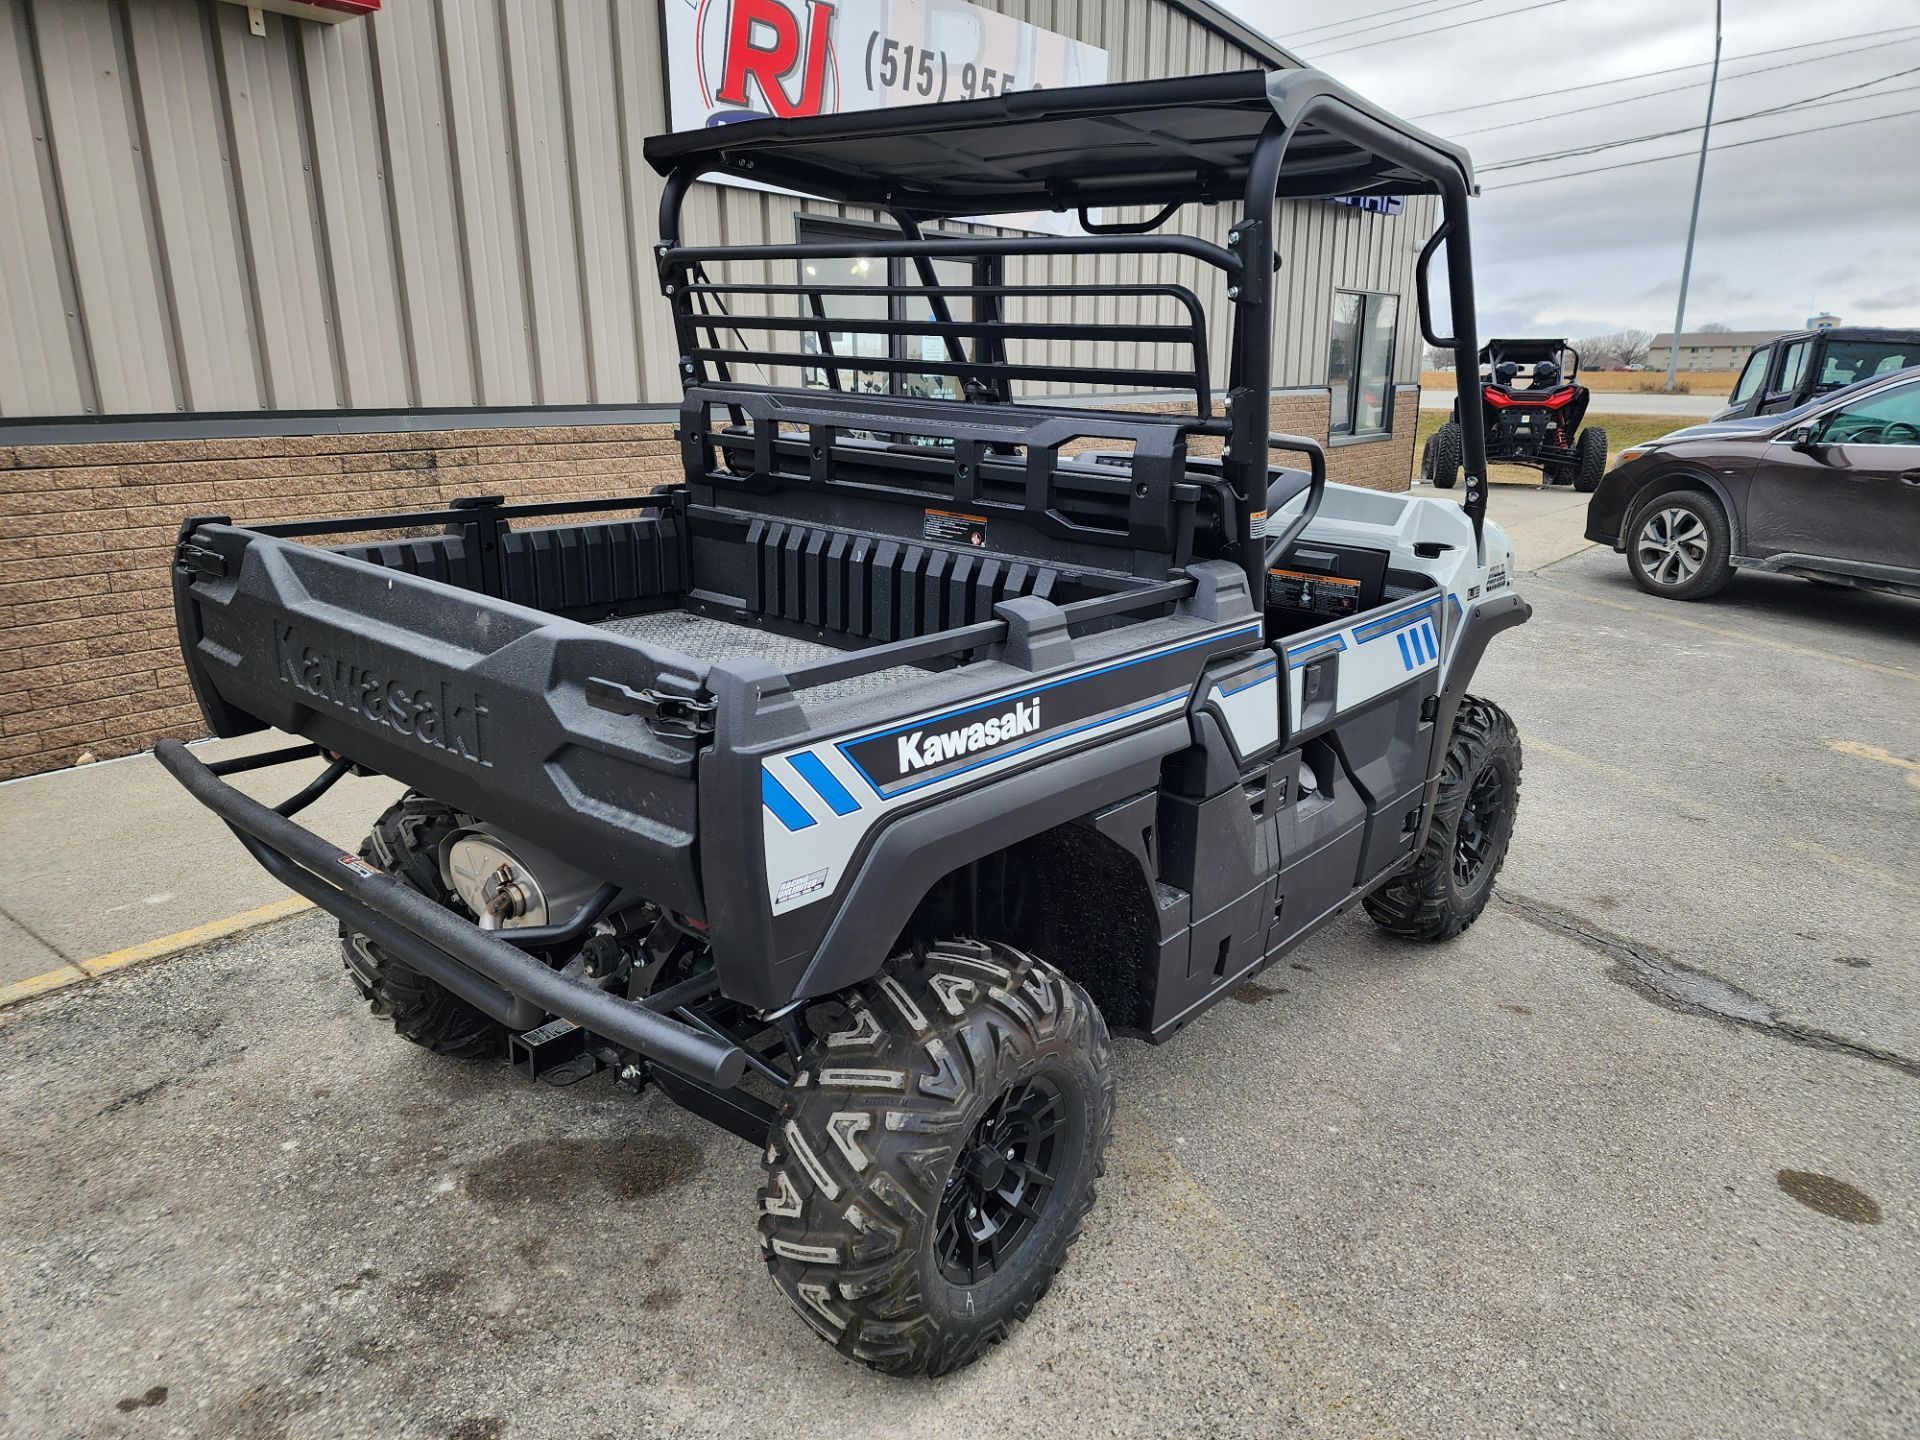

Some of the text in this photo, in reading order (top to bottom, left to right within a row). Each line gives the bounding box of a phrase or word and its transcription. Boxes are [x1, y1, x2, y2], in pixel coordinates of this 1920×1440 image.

[865, 30, 948, 102] (515)
[273, 618, 494, 768] Kawasaki
[897, 697, 1040, 774] Kawasaki
